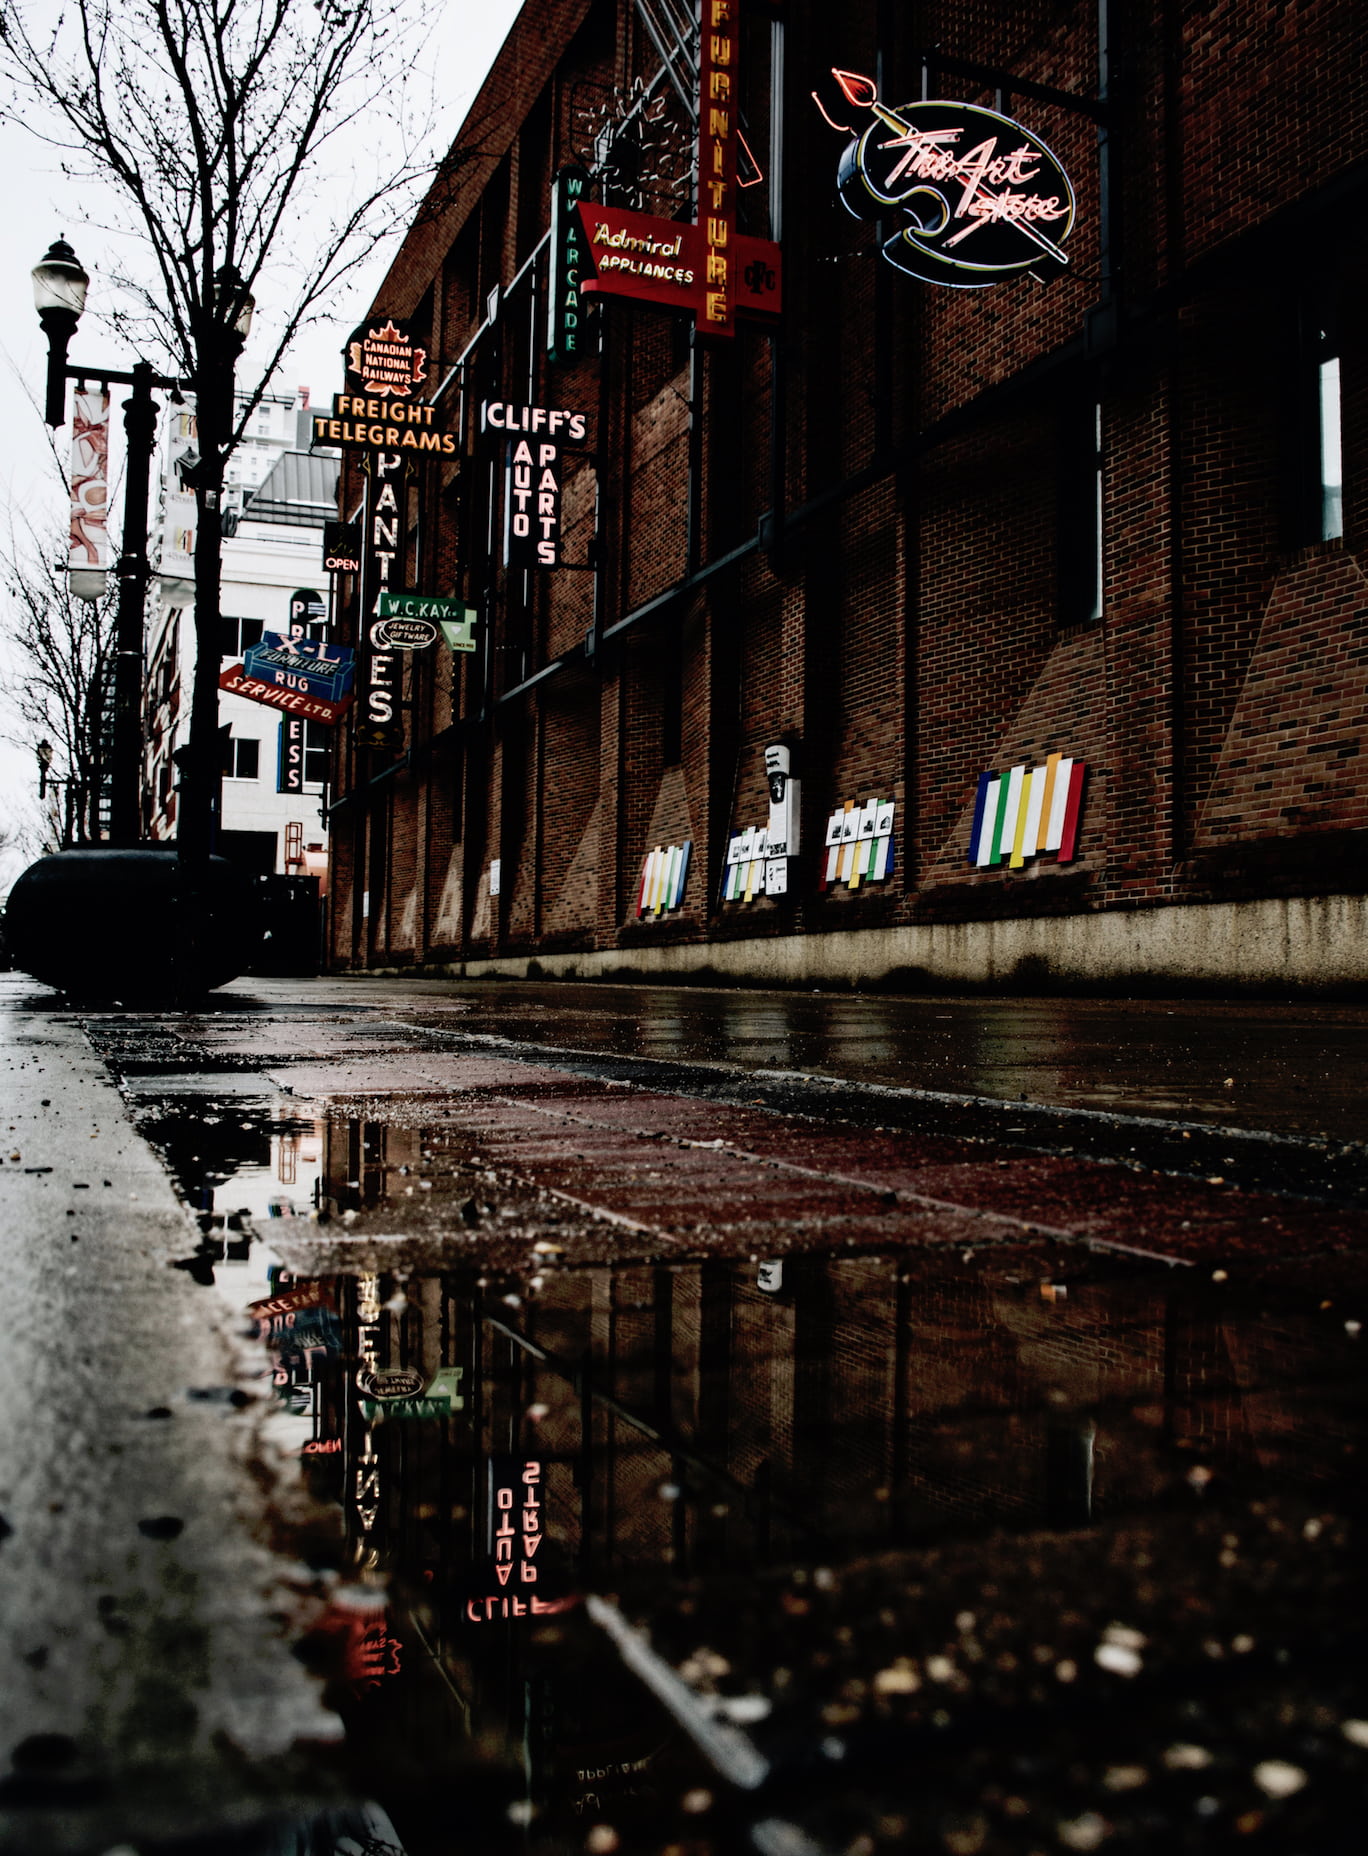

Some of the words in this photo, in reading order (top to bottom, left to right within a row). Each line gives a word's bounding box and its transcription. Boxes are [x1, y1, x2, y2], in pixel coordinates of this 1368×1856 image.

[706, 0, 732, 322] FURNITURE
[877, 128, 964, 189] The
[951, 137, 1042, 218] Art
[593, 222, 682, 257] Admiral
[599, 254, 694, 285] APPLIANCES
[363, 339, 412, 358] CANADIAN
[365, 354, 411, 370] NATIONAL
[362, 366, 412, 385] RAILWAYS
[338, 395, 436, 425] FREIGHT
[487, 402, 585, 439] CLIFF'S
[315, 417, 456, 454] TELEGRAMS
[513, 440, 534, 537] AUTO
[537, 444, 559, 565] PARTS
[325, 557, 359, 571] OPEN
[388, 622, 425, 632] JEWELRY
[274, 633, 340, 664] X-L
[225, 676, 305, 709] SERVICE
[303, 702, 333, 720] LTD.
[275, 671, 309, 692] RUG
[287, 601, 305, 788] PRESS
